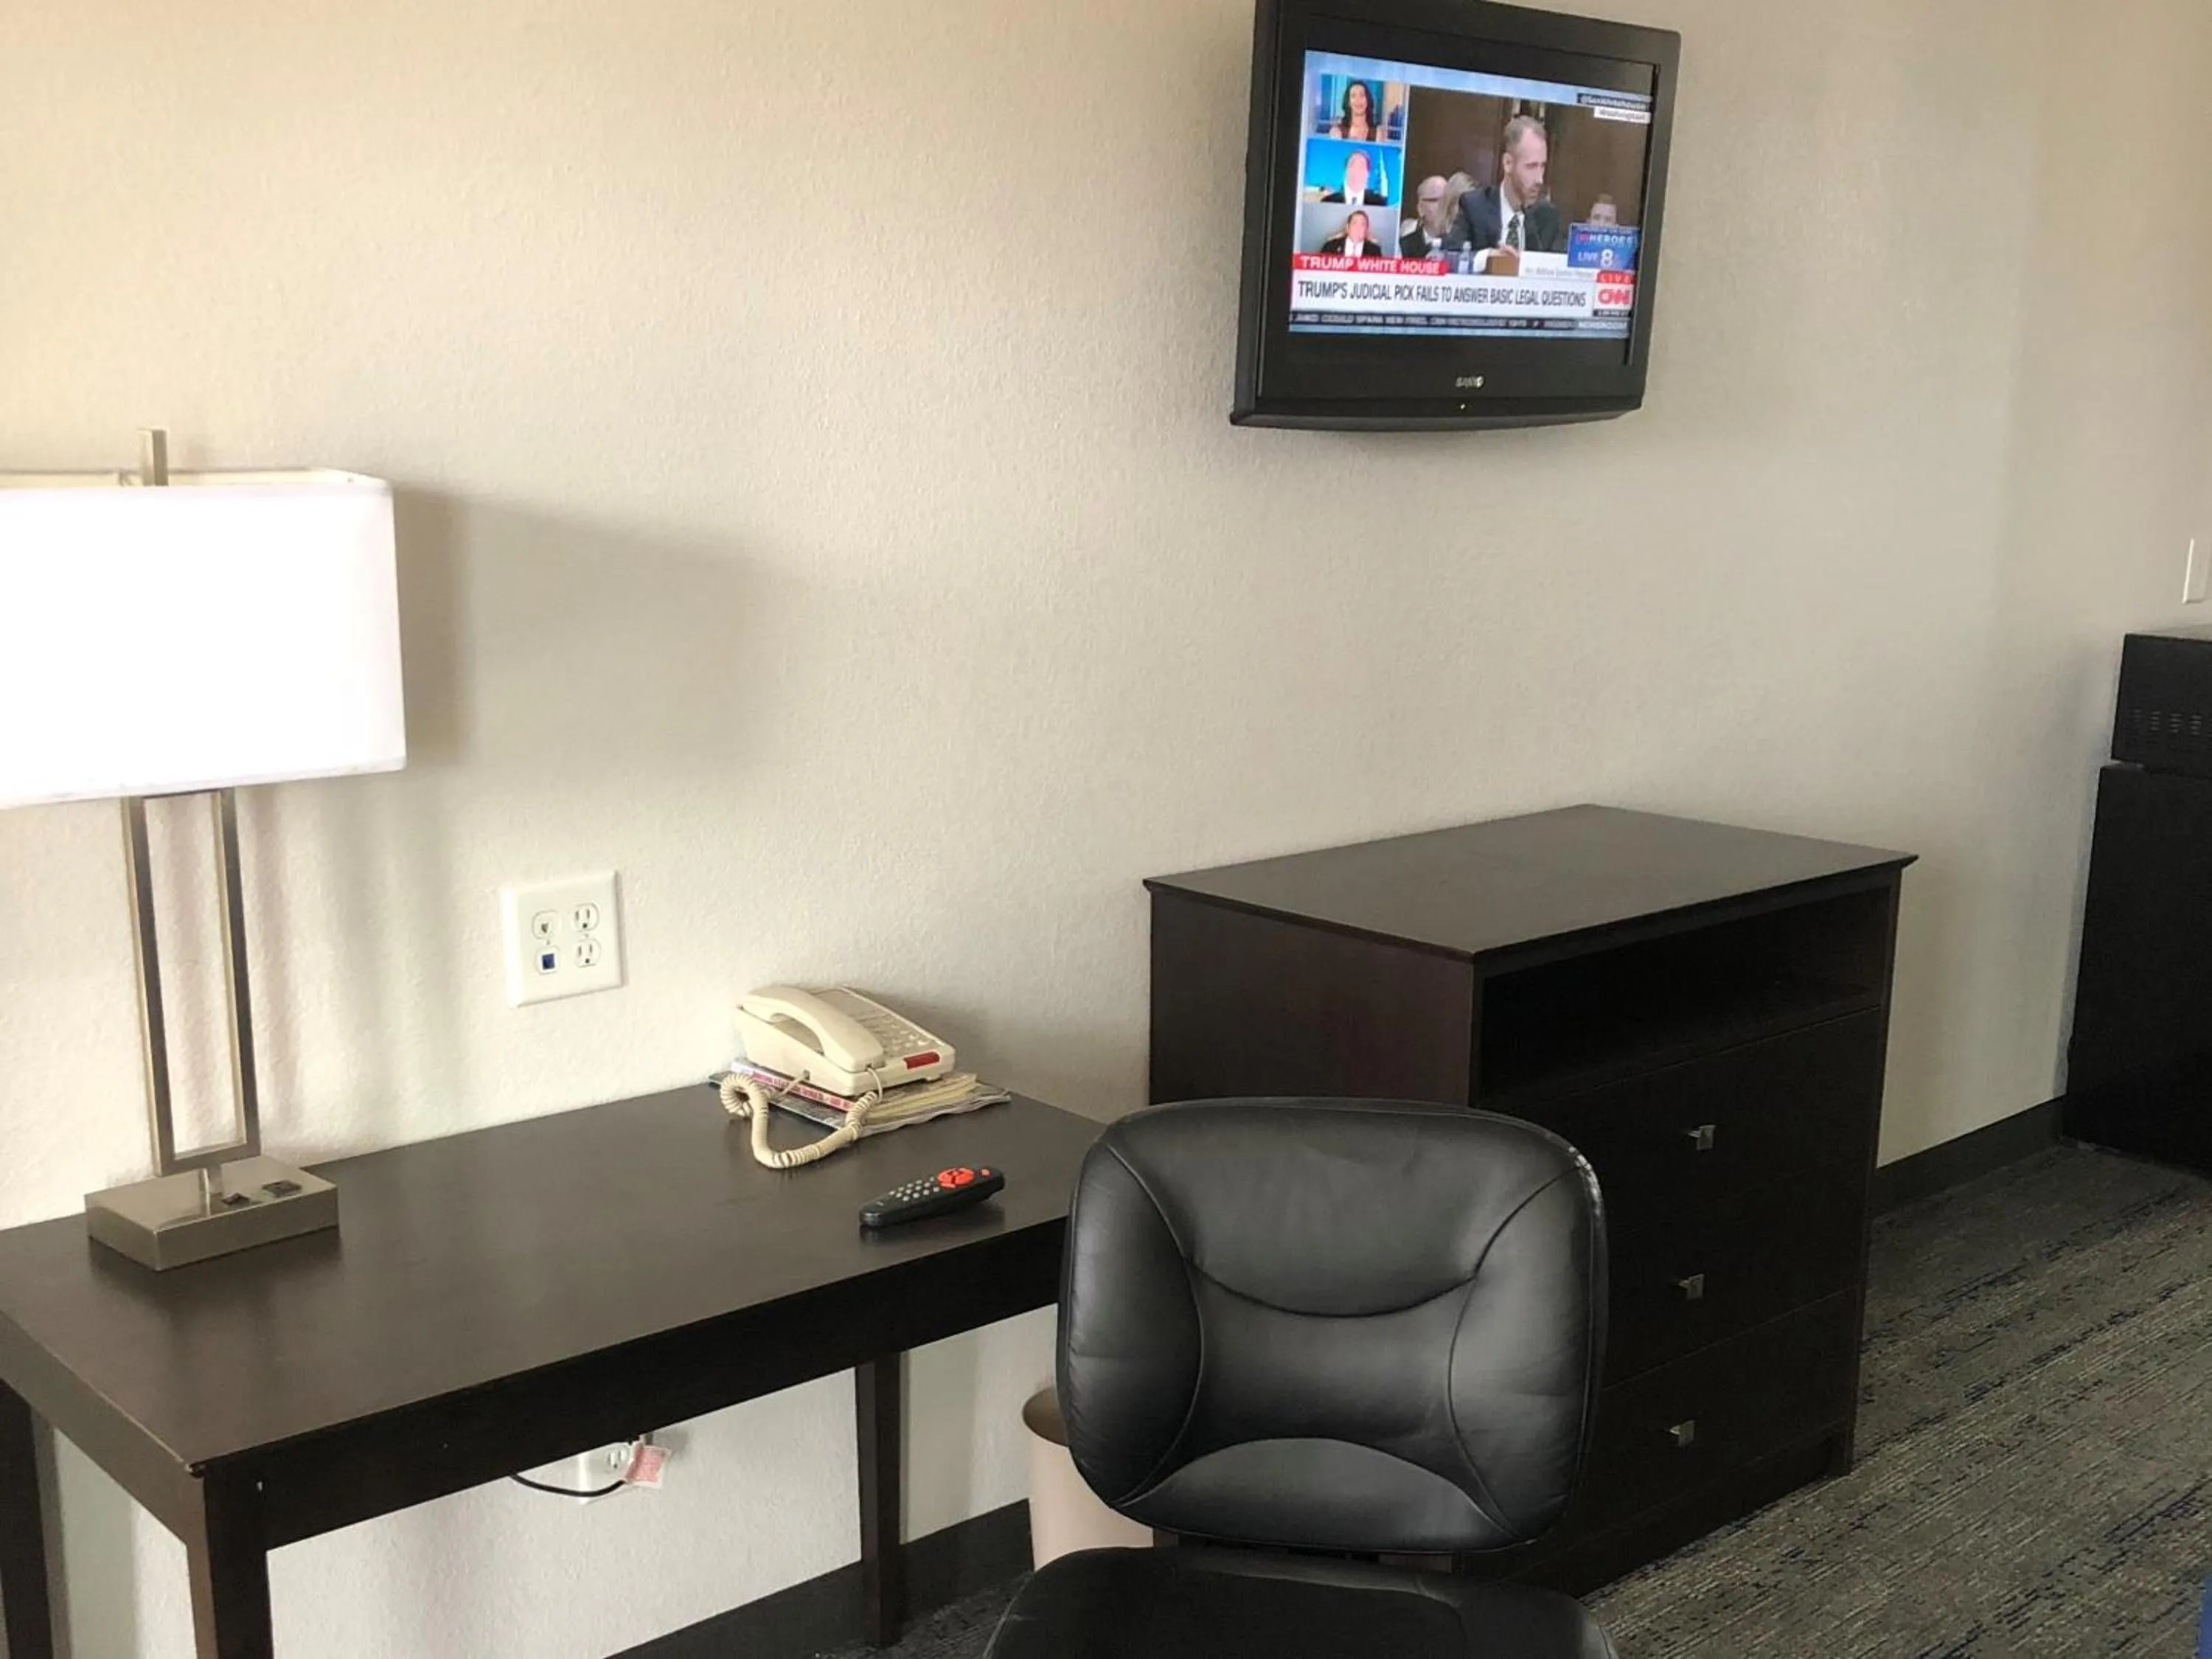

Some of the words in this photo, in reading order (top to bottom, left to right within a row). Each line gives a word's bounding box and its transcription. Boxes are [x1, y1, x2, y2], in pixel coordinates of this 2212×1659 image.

[1301, 255, 1354, 271] TRUMP
[1357, 259, 1398, 273] WHITE
[1401, 260, 1440, 274] HOUSE
[1601, 248, 1613, 266] 8
[1601, 274, 1632, 284] LIVE
[1298, 280, 1348, 300] TRUMP'S
[1349, 282, 1391, 302] JUDICIAL
[1395, 285, 1414, 302] PICK
[1416, 286, 1439, 302] FAILS
[1441, 287, 1452, 303] TO
[1453, 287, 1489, 304] ANSWER
[1490, 288, 1514, 305] BASIC
[1515, 290, 1539, 306] LEGAL
[1542, 291, 1586, 307] QUESTIONS
[1598, 288, 1631, 305] CNN
